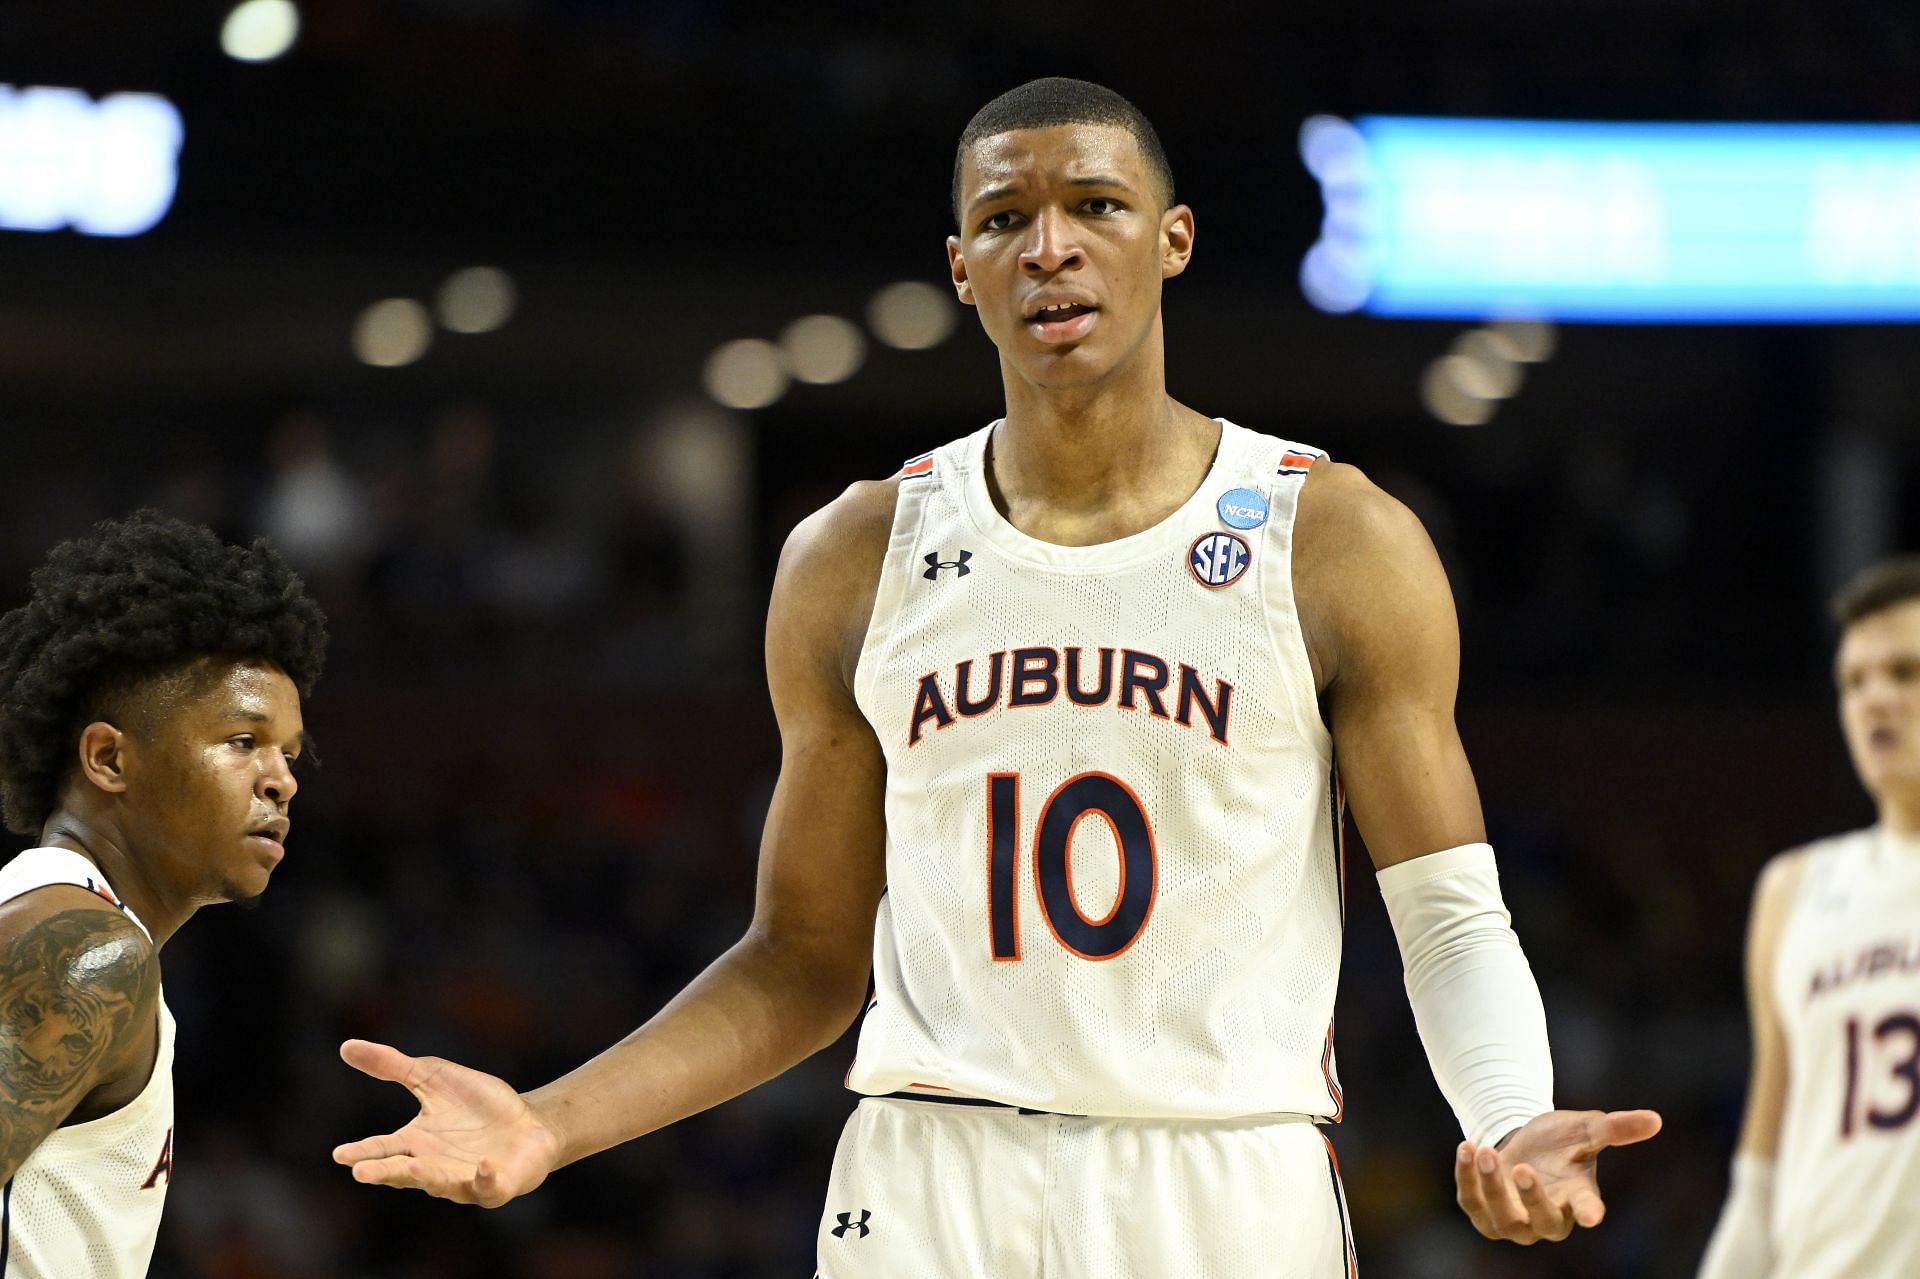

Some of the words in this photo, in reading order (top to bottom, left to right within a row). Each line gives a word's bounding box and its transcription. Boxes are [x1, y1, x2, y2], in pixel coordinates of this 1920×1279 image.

[1194, 534, 1247, 584] SEC
[1224, 503, 1265, 521] NCAA
[908, 645, 1235, 748] AUBURN
[986, 770, 1160, 963] 10
[1841, 1013, 1920, 1140] 13
